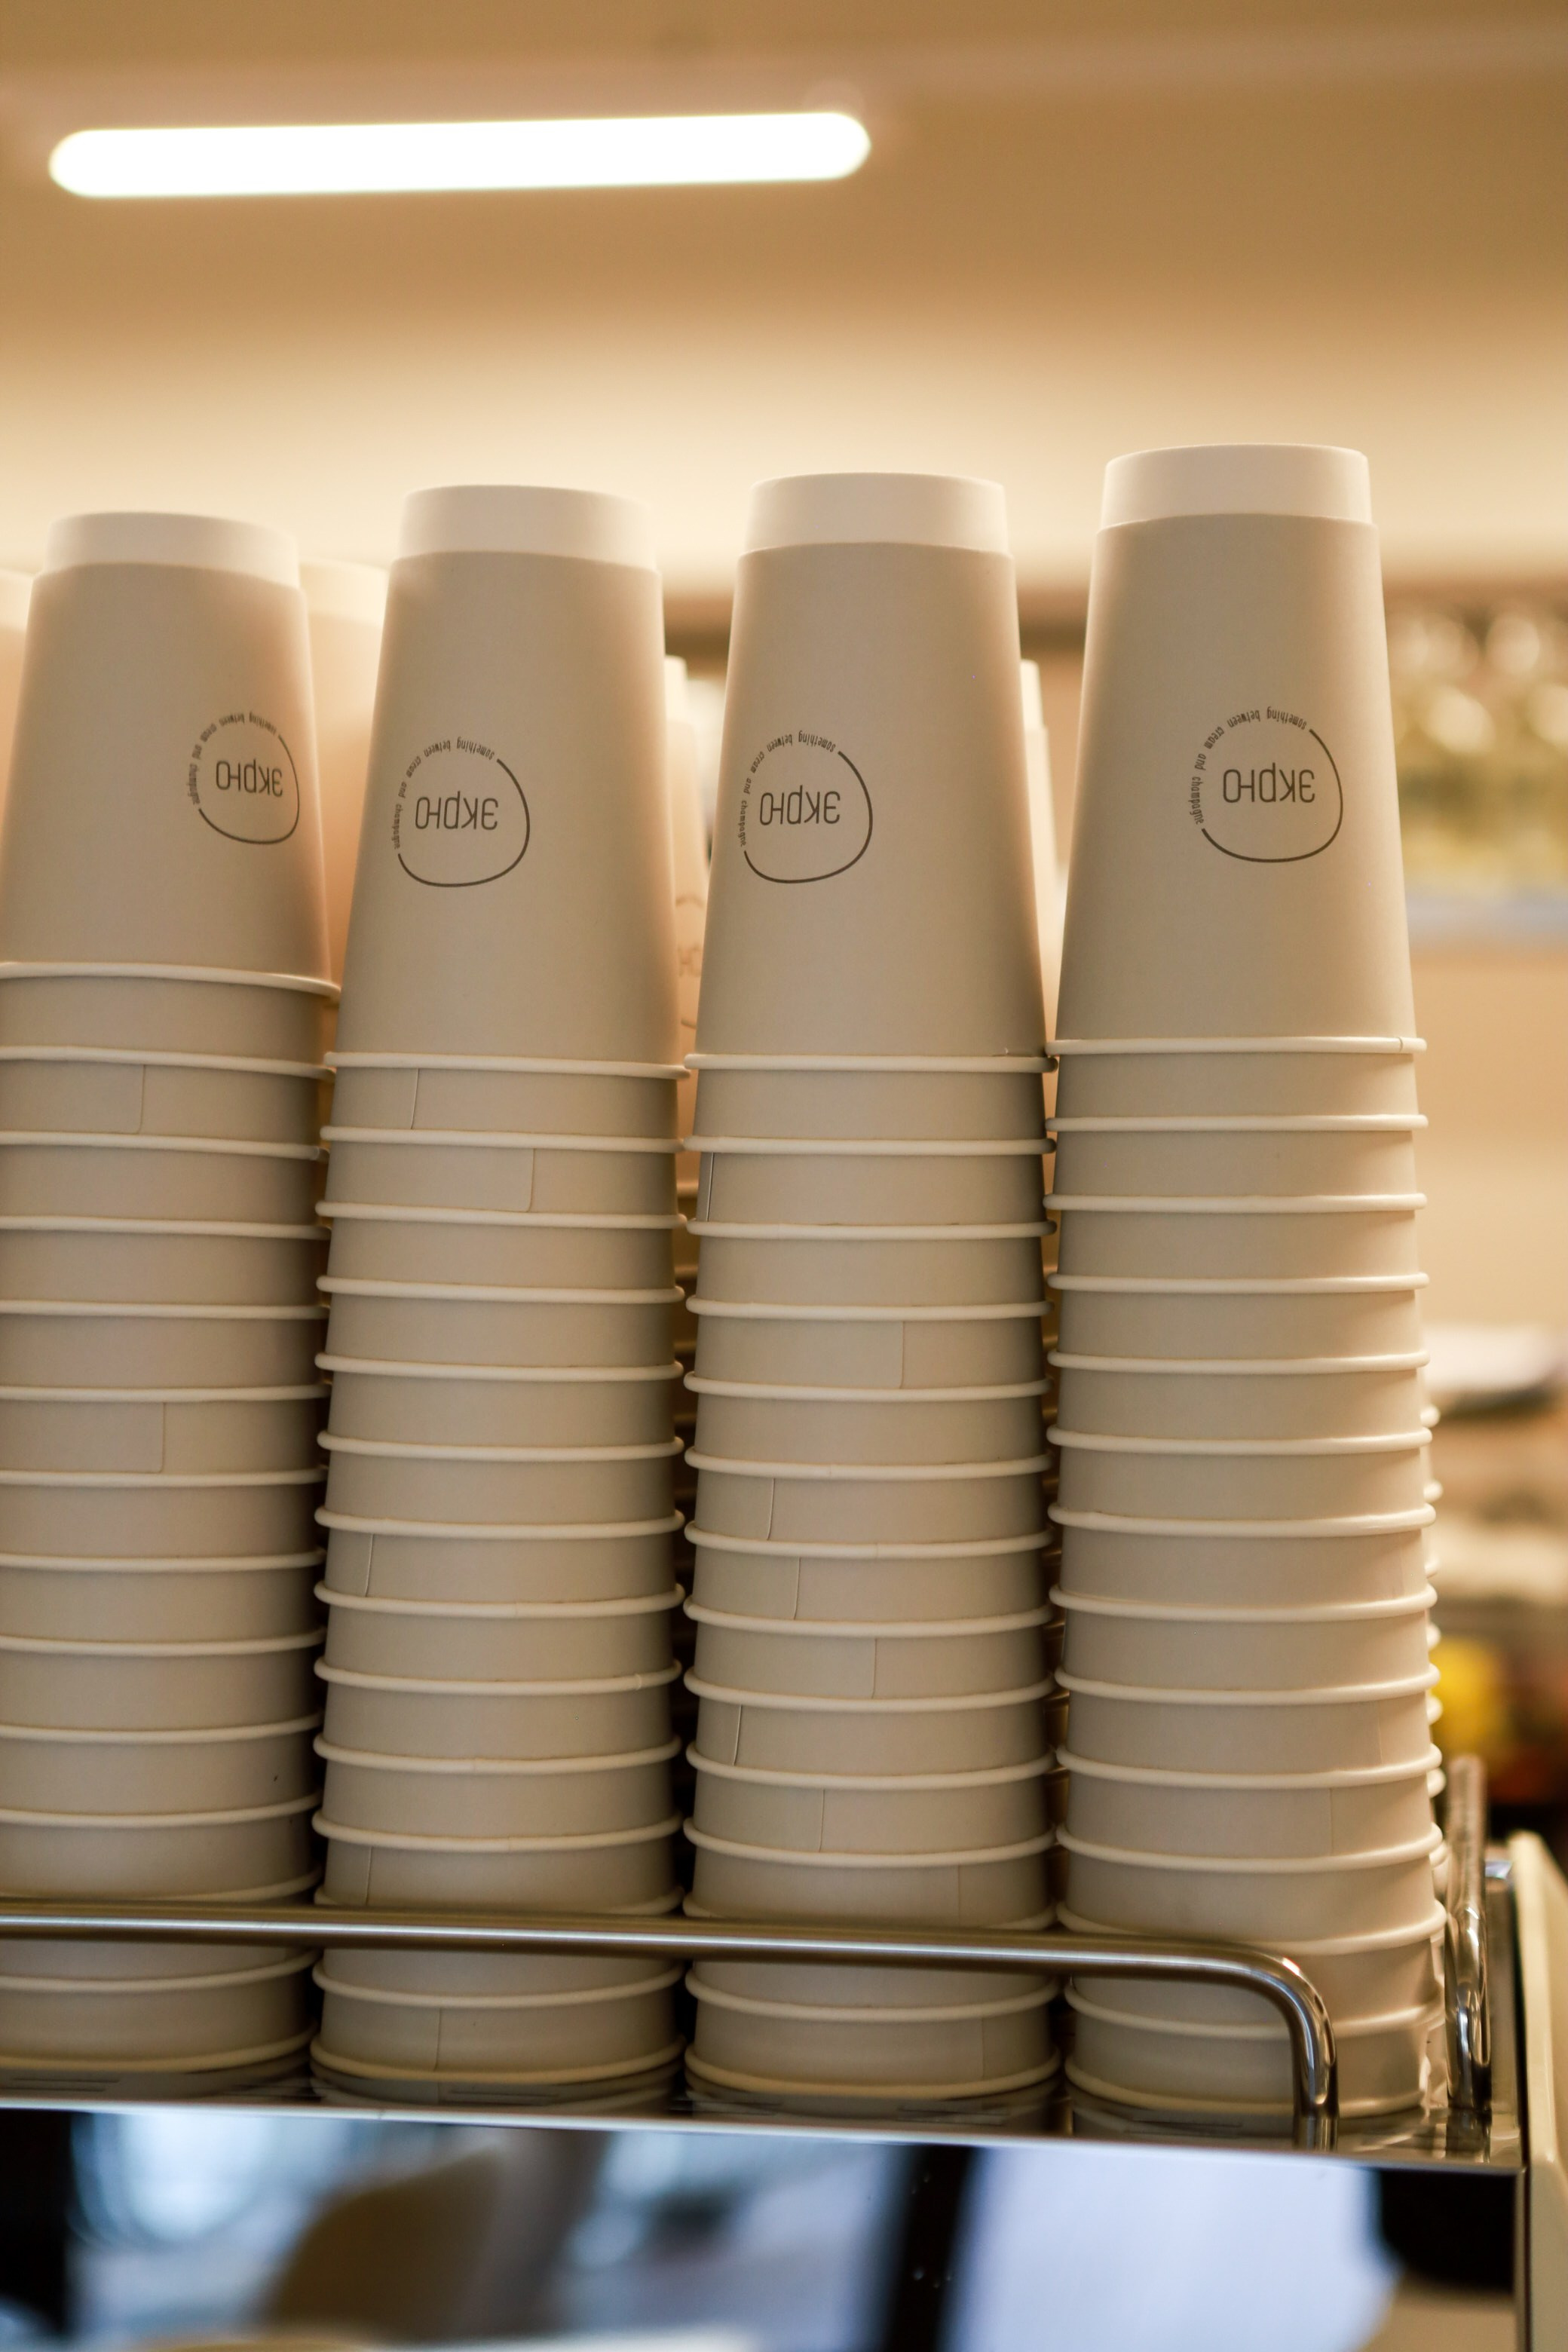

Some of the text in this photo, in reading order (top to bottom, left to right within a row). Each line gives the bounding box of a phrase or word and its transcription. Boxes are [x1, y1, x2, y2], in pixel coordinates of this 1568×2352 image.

[424, 740, 451, 758] between
[456, 737, 495, 761] something
[767, 734, 792, 752] between
[798, 730, 835, 753] something
[406, 756, 421, 778] cream
[751, 752, 764, 773] cream
[1188, 706, 1306, 825] something between cream and champagne
[398, 782, 407, 798] and
[737, 801, 748, 847] champagne
